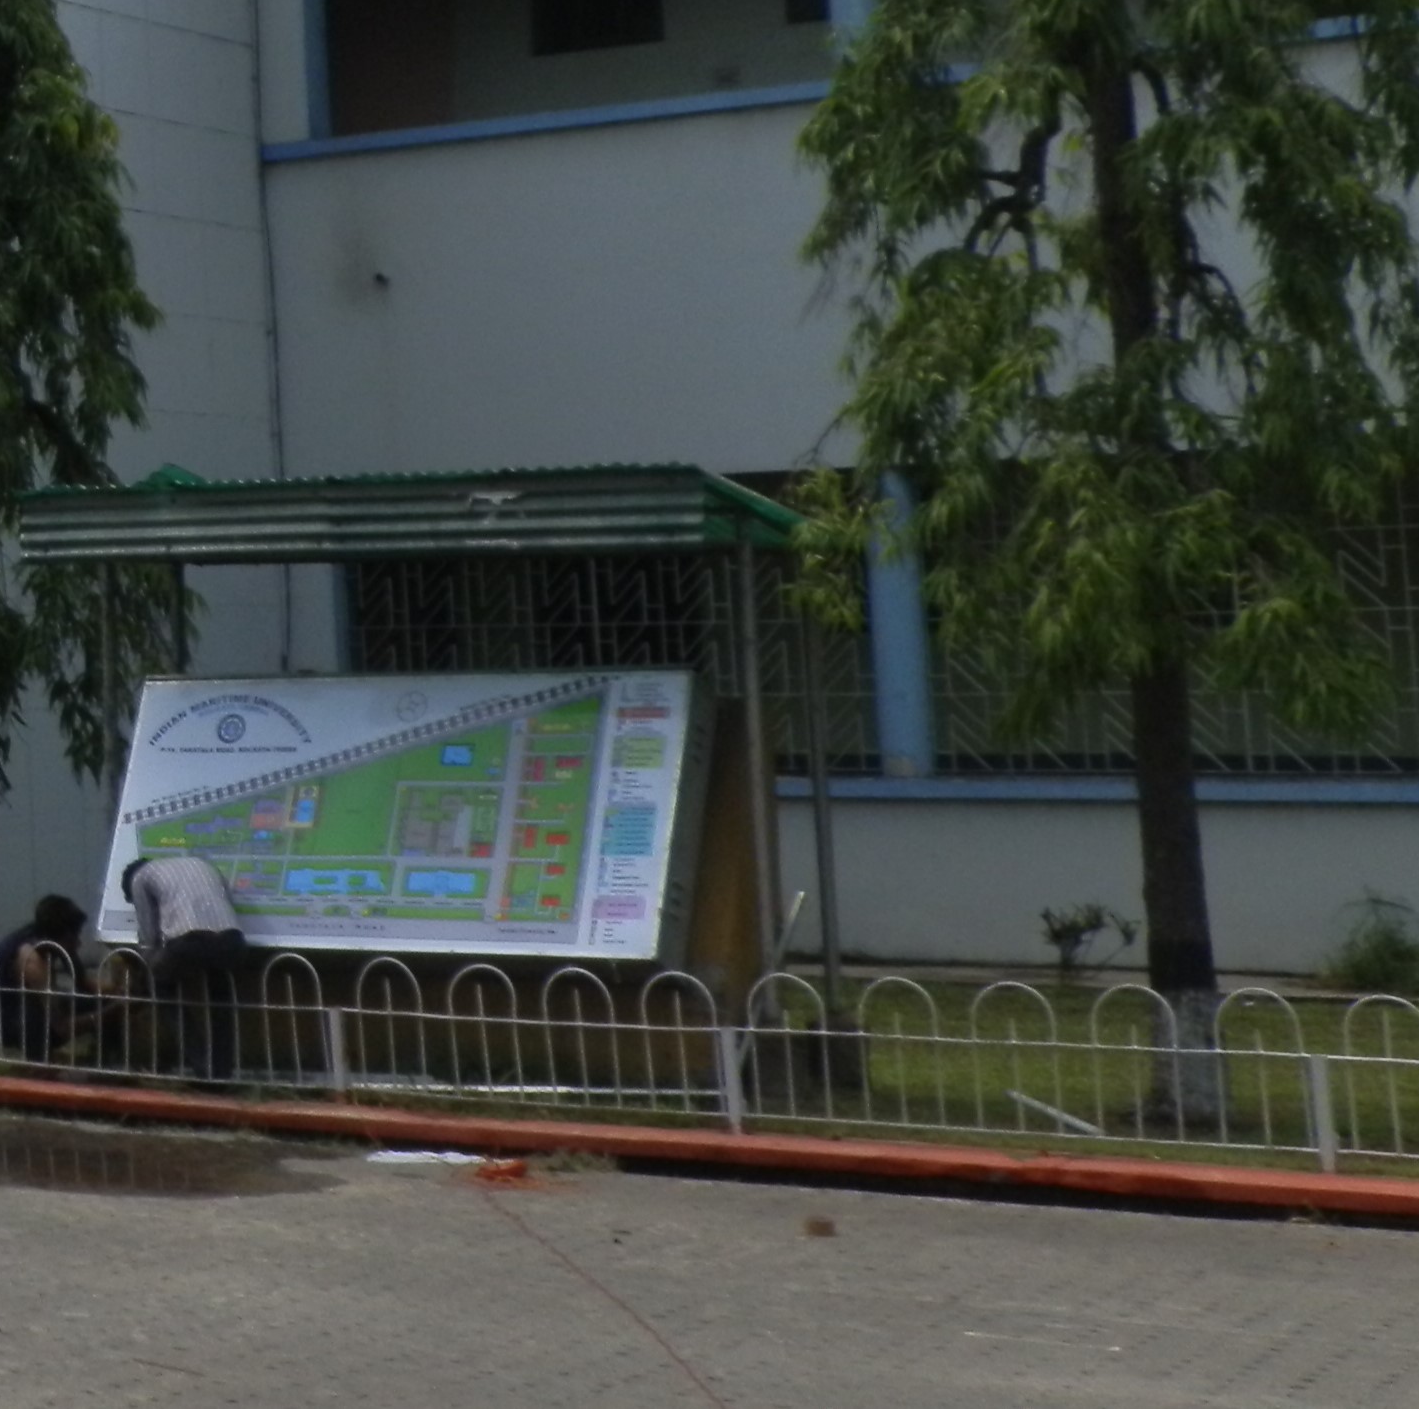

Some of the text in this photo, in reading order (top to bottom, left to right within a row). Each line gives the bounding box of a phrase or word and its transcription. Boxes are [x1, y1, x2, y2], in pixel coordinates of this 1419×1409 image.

[149, 710, 188, 746] INDIAN
[190, 694, 249, 713] MARITIME
[254, 695, 312, 743] UNIVERSITY
